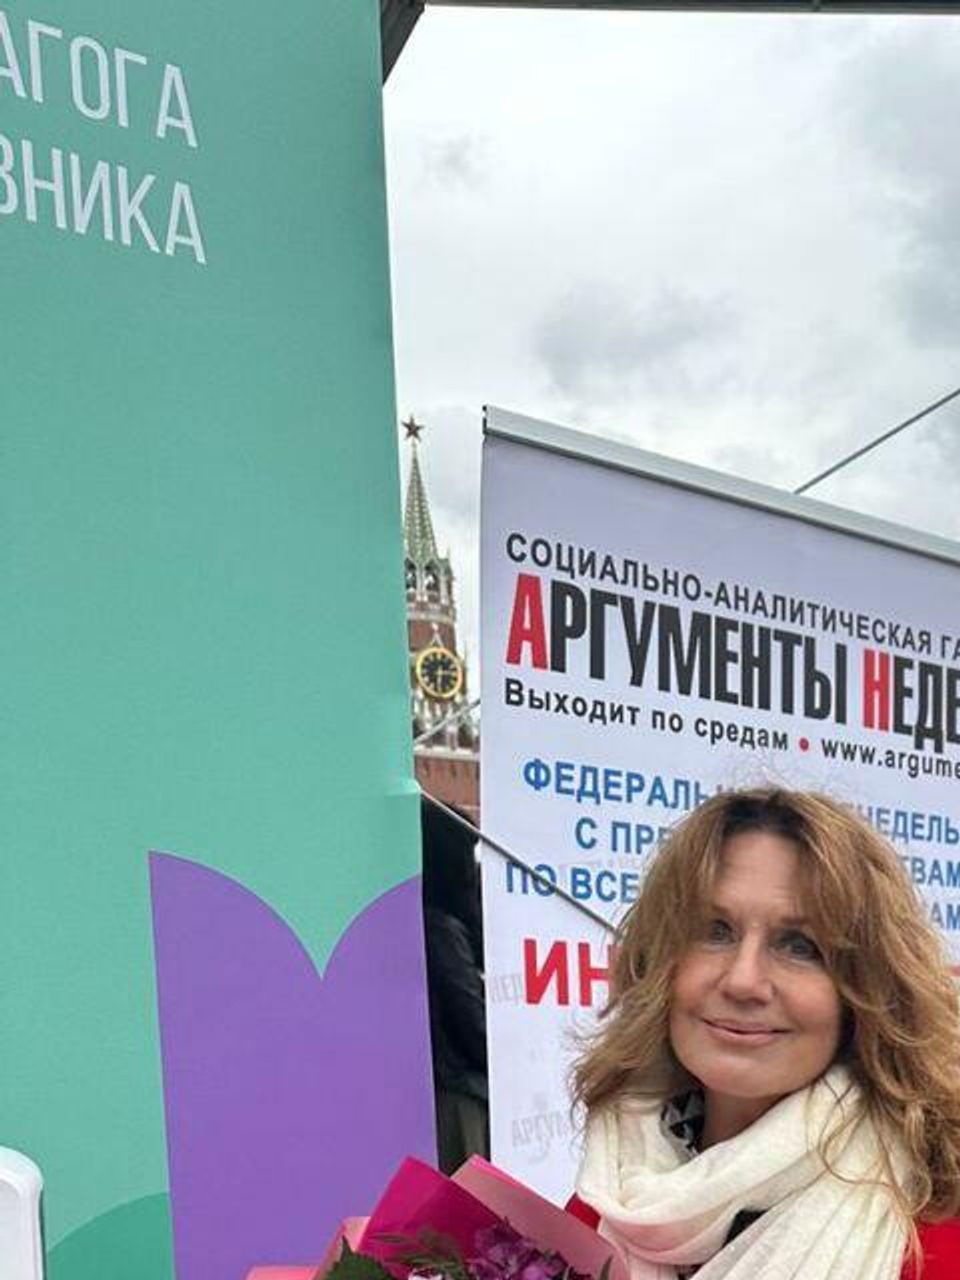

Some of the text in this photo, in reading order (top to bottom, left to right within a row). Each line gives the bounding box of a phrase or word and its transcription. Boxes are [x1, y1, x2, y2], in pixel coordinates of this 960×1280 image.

[505, 533, 932, 653] СОЦИАЛЬНО-АНАЛИТИЧЕСКАЯ
[505, 572, 847, 725] АРГУМЕНТЫ
[505, 677, 789, 752] Выходит по средам
[523, 758, 710, 811] ФЕДЕРАЛЬ
[575, 817, 597, 850] С
[506, 861, 557, 897] ПО
